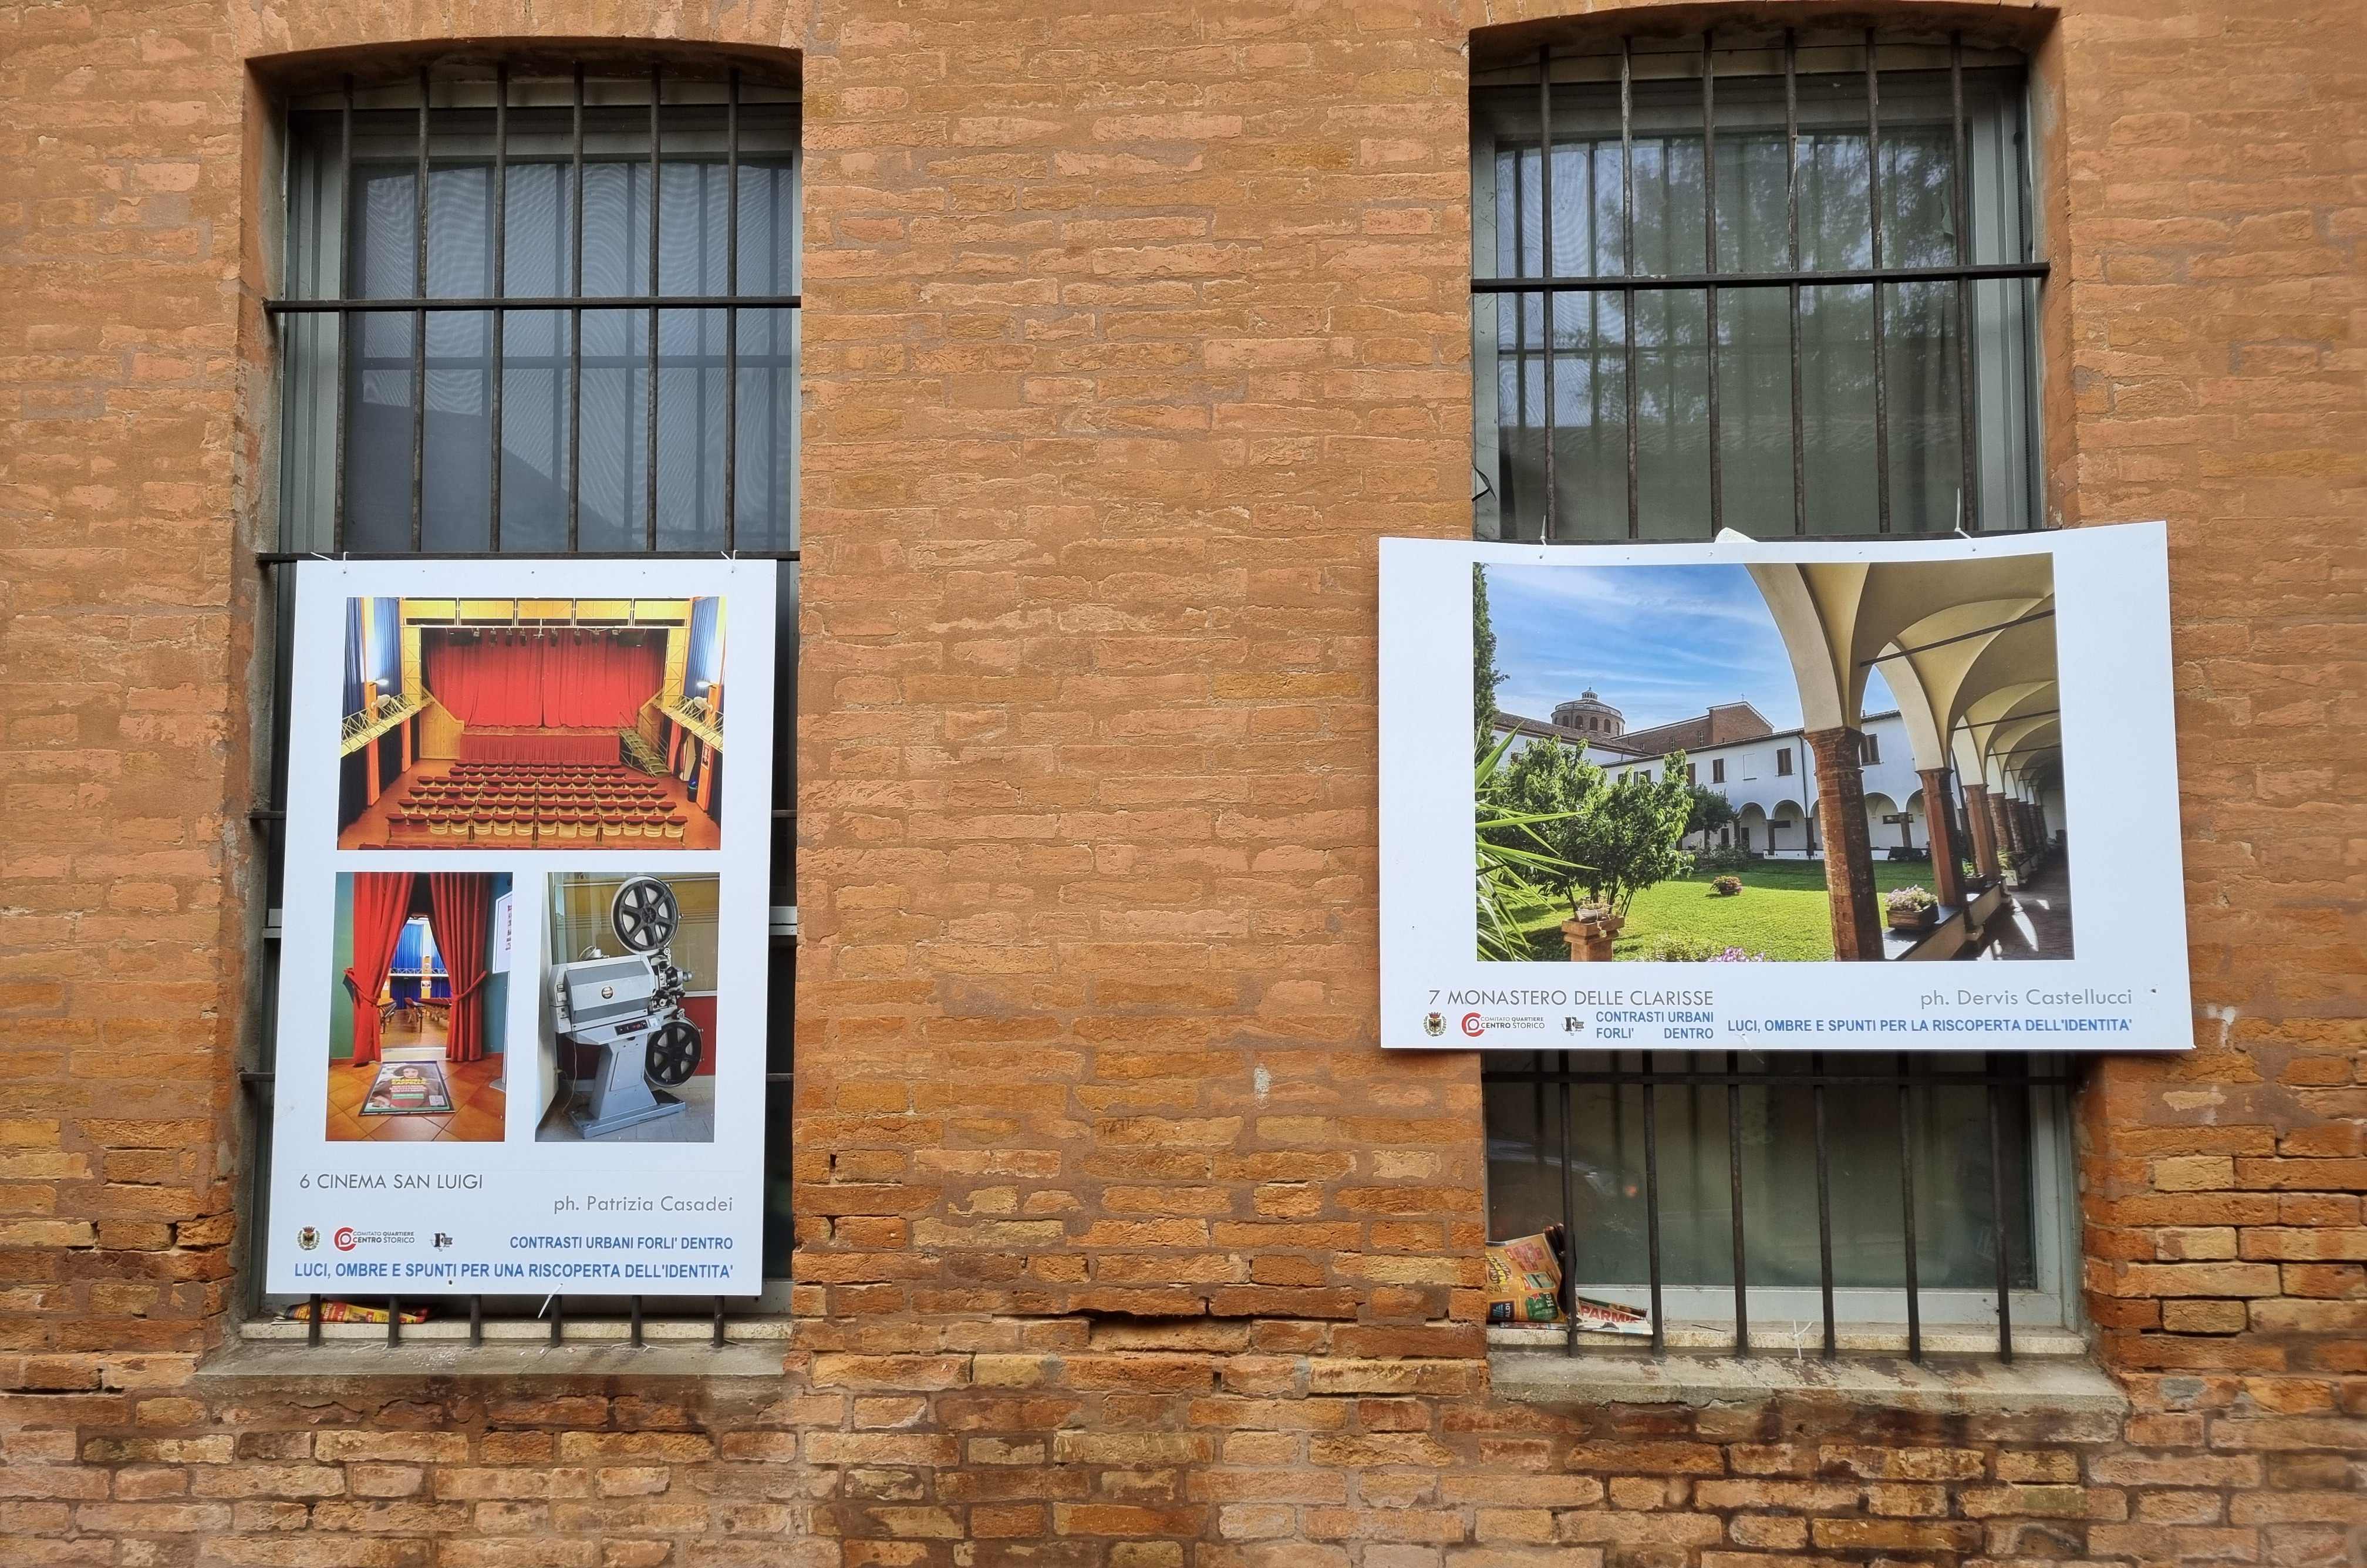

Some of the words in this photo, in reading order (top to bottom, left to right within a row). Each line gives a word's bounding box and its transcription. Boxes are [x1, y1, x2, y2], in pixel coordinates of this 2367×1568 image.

[1429, 990, 1441, 1004] 7
[1448, 990, 1566, 1005] MONASTERO
[1575, 991, 1623, 1005] DELLE
[1630, 991, 1713, 1006] CLARISSE
[1921, 990, 1949, 1009] ph.
[1958, 990, 2018, 1004] Dervis
[2027, 989, 2131, 1004] Castellucci
[1596, 1011, 1664, 1022] CONTRASTI
[1668, 1011, 1713, 1022] URBANI
[1597, 1028, 1634, 1038] FORLI'
[1664, 1028, 1713, 1038] DENTRO
[1728, 1020, 1760, 1034] LUCI,
[1765, 1020, 1812, 1031] OMBRE
[1816, 1020, 1824, 1031] E
[1829, 1020, 1876, 1031] SPUNTI
[1880, 1020, 1907, 1031] PER
[1911, 1020, 1929, 1031] LA
[1933, 1020, 2021, 1031] RISCOPERTA
[2025, 1019, 2132, 1031] DELL'IDENTITA'
[300, 1174, 310, 1188] 6
[318, 1174, 386, 1189] CINEMA
[393, 1174, 430, 1189] SAN
[438, 1174, 482, 1189] LUIGI
[555, 1196, 579, 1214] ph.
[588, 1196, 653, 1211] Patrizia
[661, 1196, 732, 1212] Casadei
[510, 1236, 582, 1249] CONTRASTI
[586, 1237, 633, 1249] URBANI
[638, 1237, 677, 1249] FORLI'
[682, 1237, 733, 1250] DENTRO
[295, 1263, 331, 1279] LUCI,
[336, 1263, 387, 1277] OMBRE
[392, 1263, 401, 1277] E
[406, 1263, 456, 1277] SPUNTI
[461, 1264, 490, 1277] PER
[494, 1264, 524, 1277] UNA
[529, 1264, 621, 1277] RISCOPERTA
[625, 1264, 733, 1278] DELL'IDENTITA'
